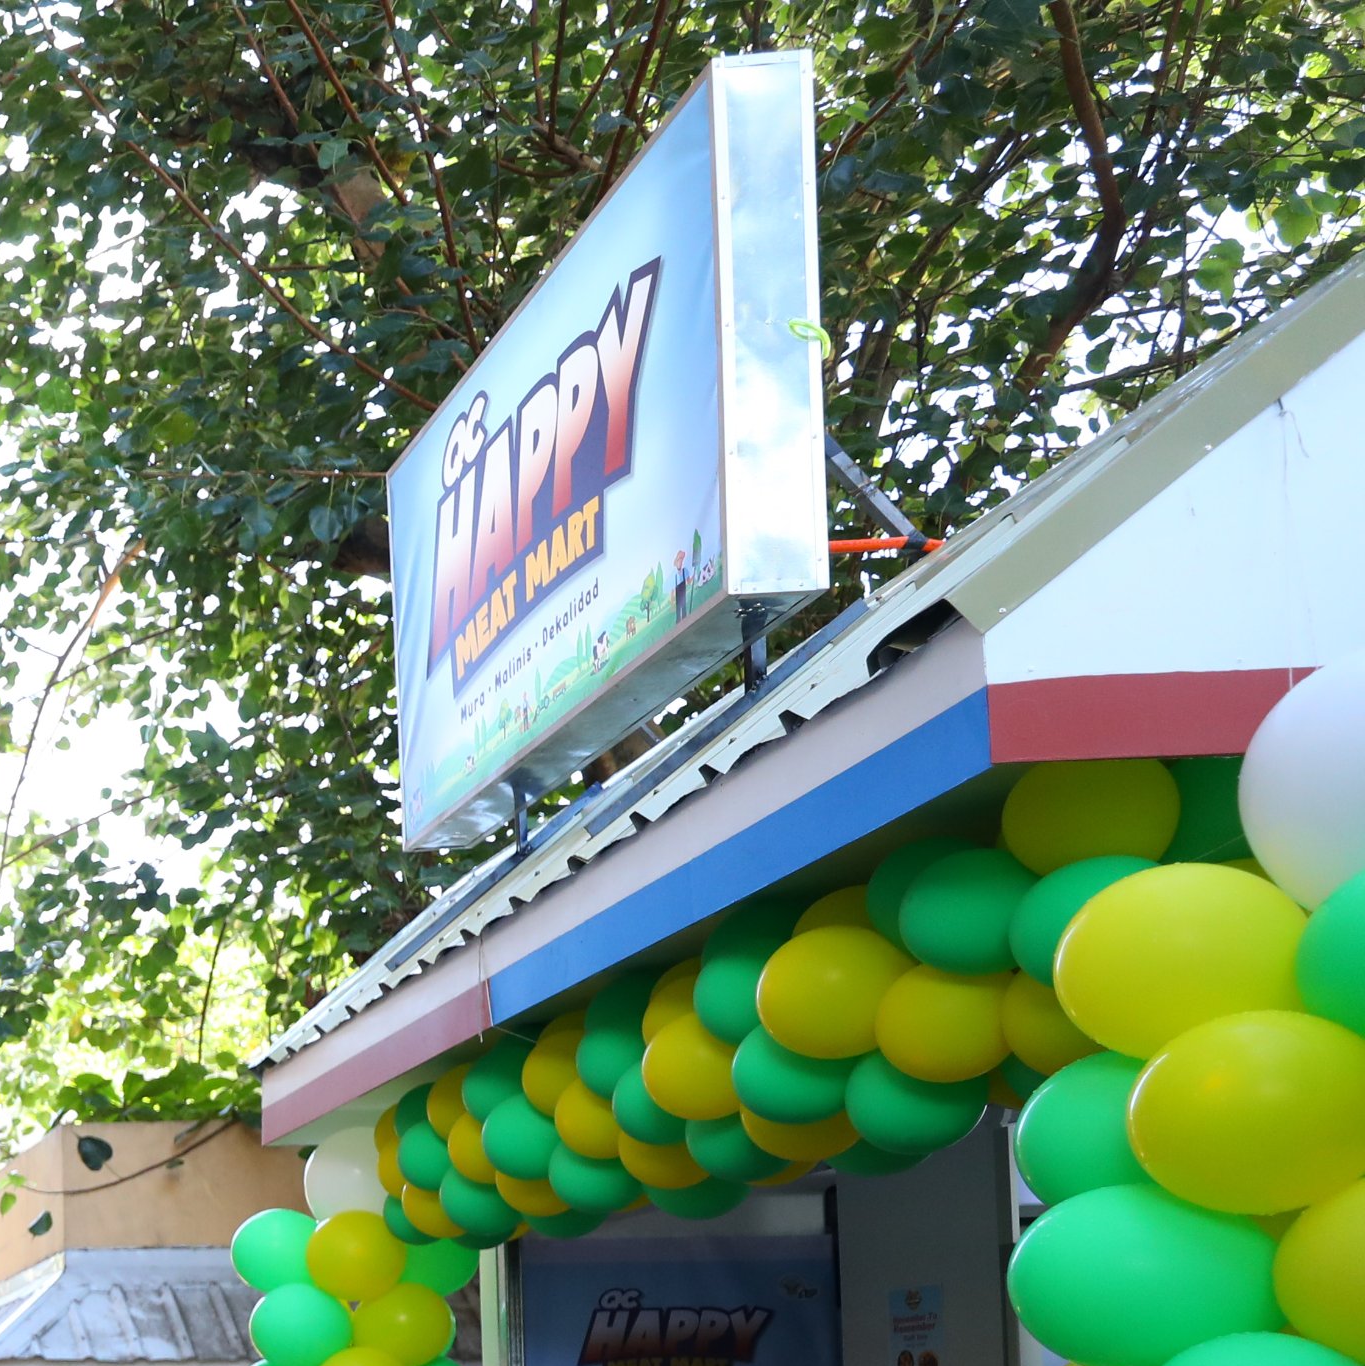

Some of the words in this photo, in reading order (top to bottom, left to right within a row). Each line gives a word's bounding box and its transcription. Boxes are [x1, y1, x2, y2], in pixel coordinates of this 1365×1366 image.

[429, 268, 657, 672] HAPPY
[444, 394, 487, 485] QC
[455, 570, 517, 680] MEAT
[525, 496, 599, 603] MART
[461, 692, 485, 724] Mura
[495, 647, 532, 692] Malinis
[542, 577, 599, 647] Dekalidad
[581, 1308, 768, 1363] HAPPY
[600, 1290, 640, 1308] QC
